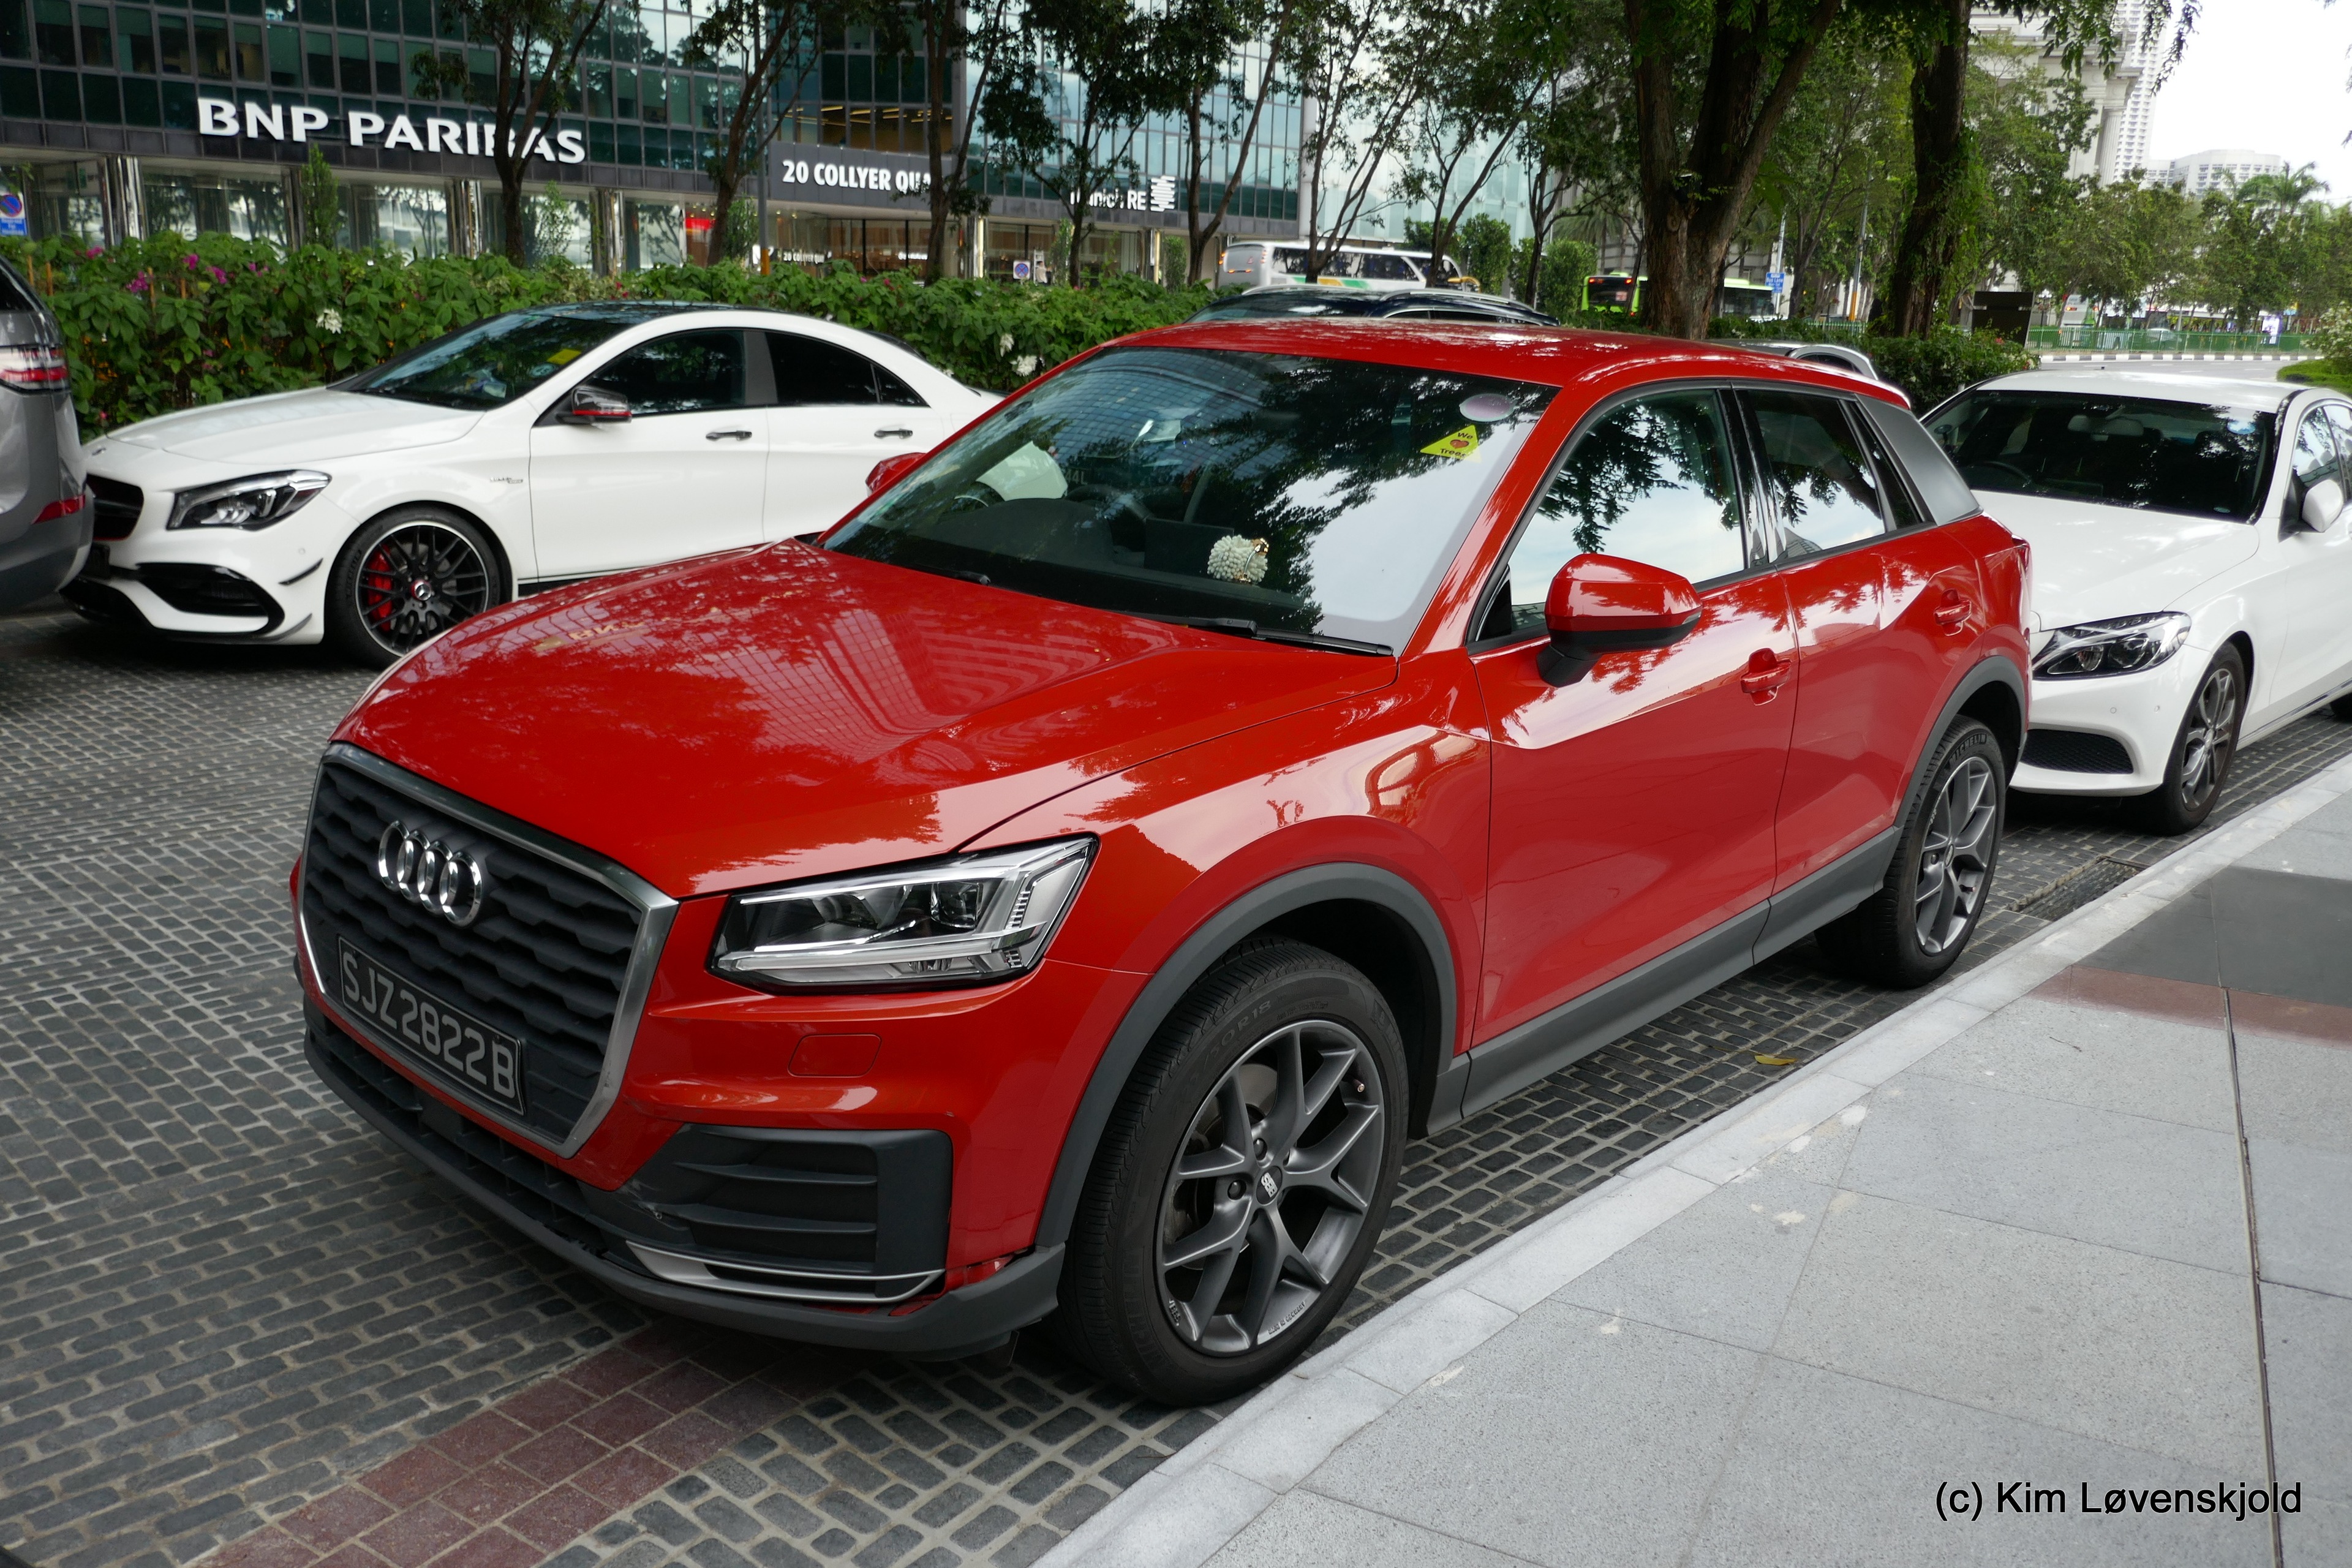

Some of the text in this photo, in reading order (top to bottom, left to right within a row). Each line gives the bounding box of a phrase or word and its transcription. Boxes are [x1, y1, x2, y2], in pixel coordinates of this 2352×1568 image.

[198, 98, 329, 142] BNP
[782, 159, 931, 194] 20 COLLYER QUA
[1127, 189, 1147, 211] RE
[783, 251, 792, 262] 20
[1949, 733, 1988, 766] MICHELIN
[342, 951, 516, 1099] SJZ2822B
